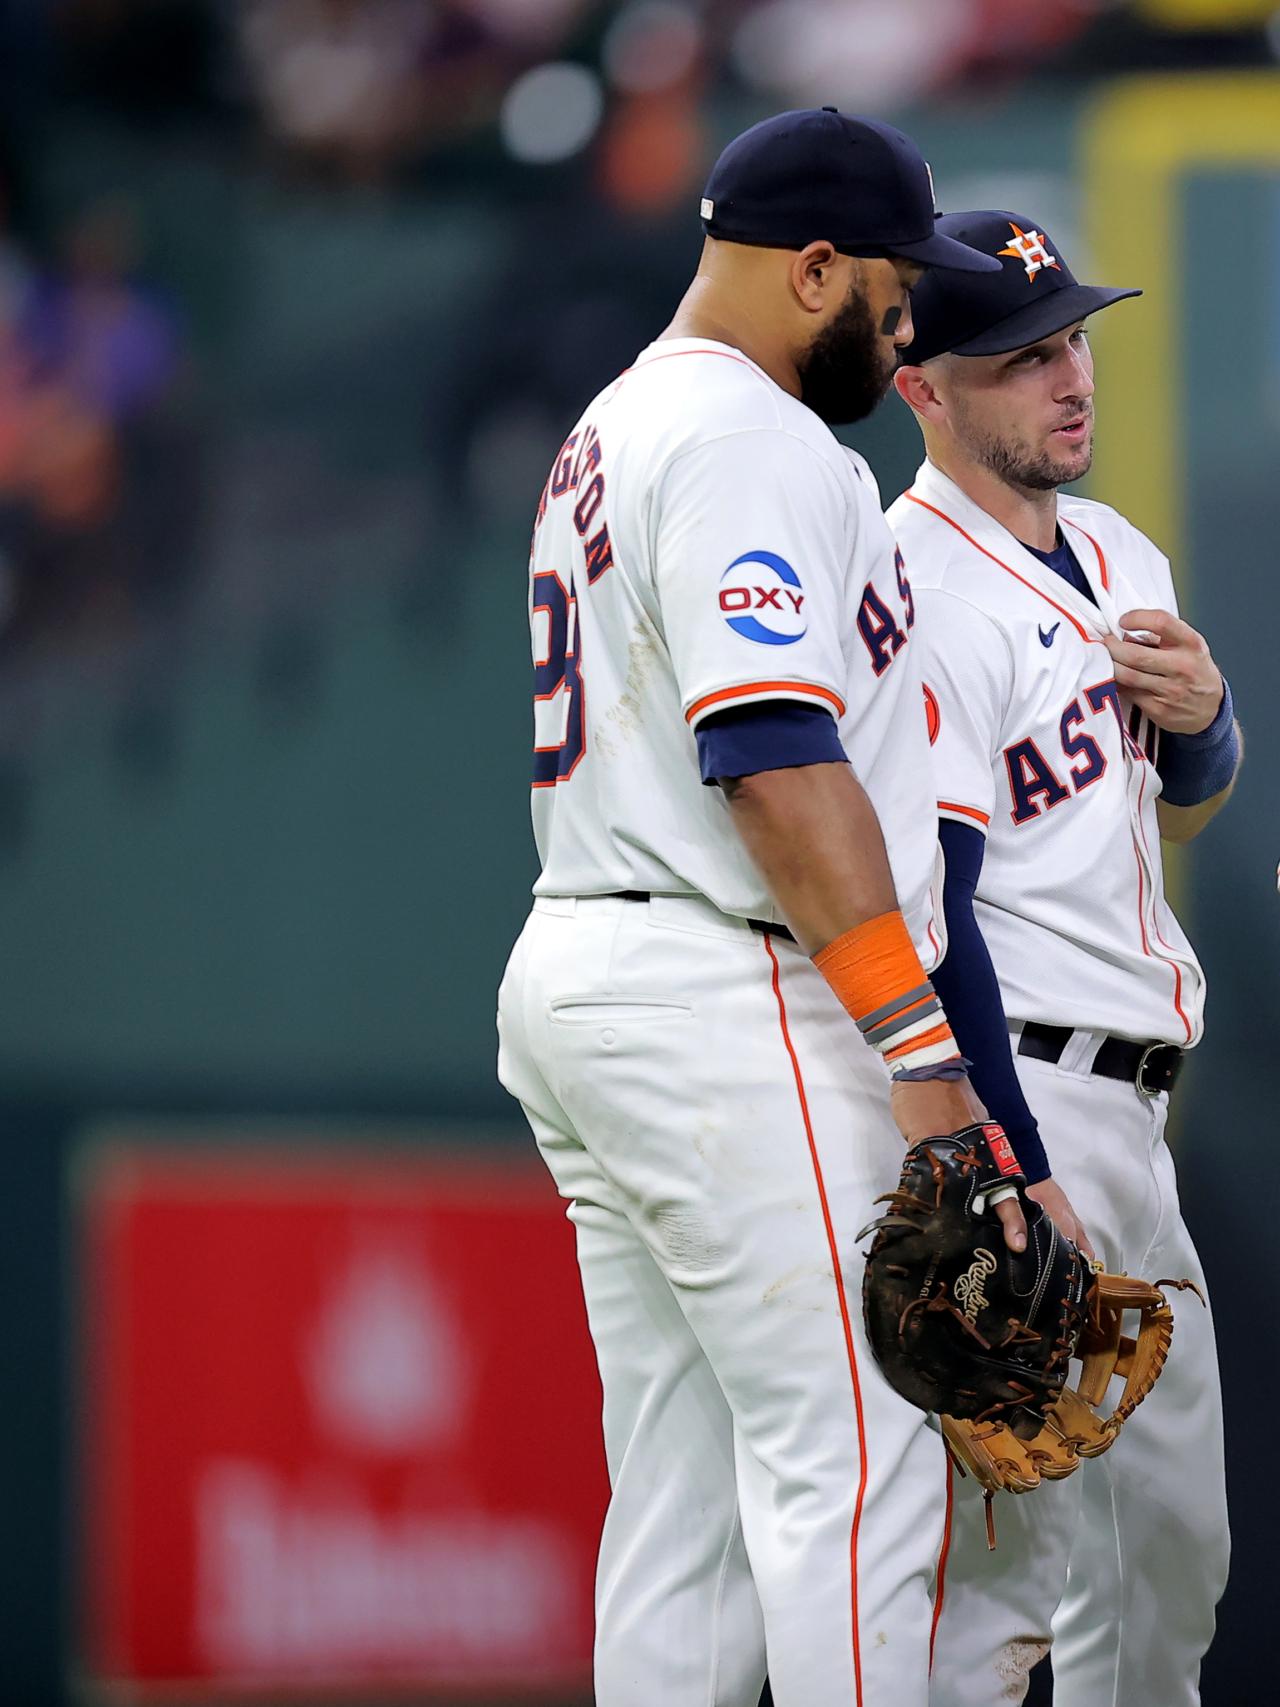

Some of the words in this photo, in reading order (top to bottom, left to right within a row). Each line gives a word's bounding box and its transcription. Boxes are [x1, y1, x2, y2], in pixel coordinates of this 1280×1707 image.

[719, 586, 804, 614] OXY
[1003, 678, 1146, 826] AST
[964, 1247, 997, 1326] Rawlin
